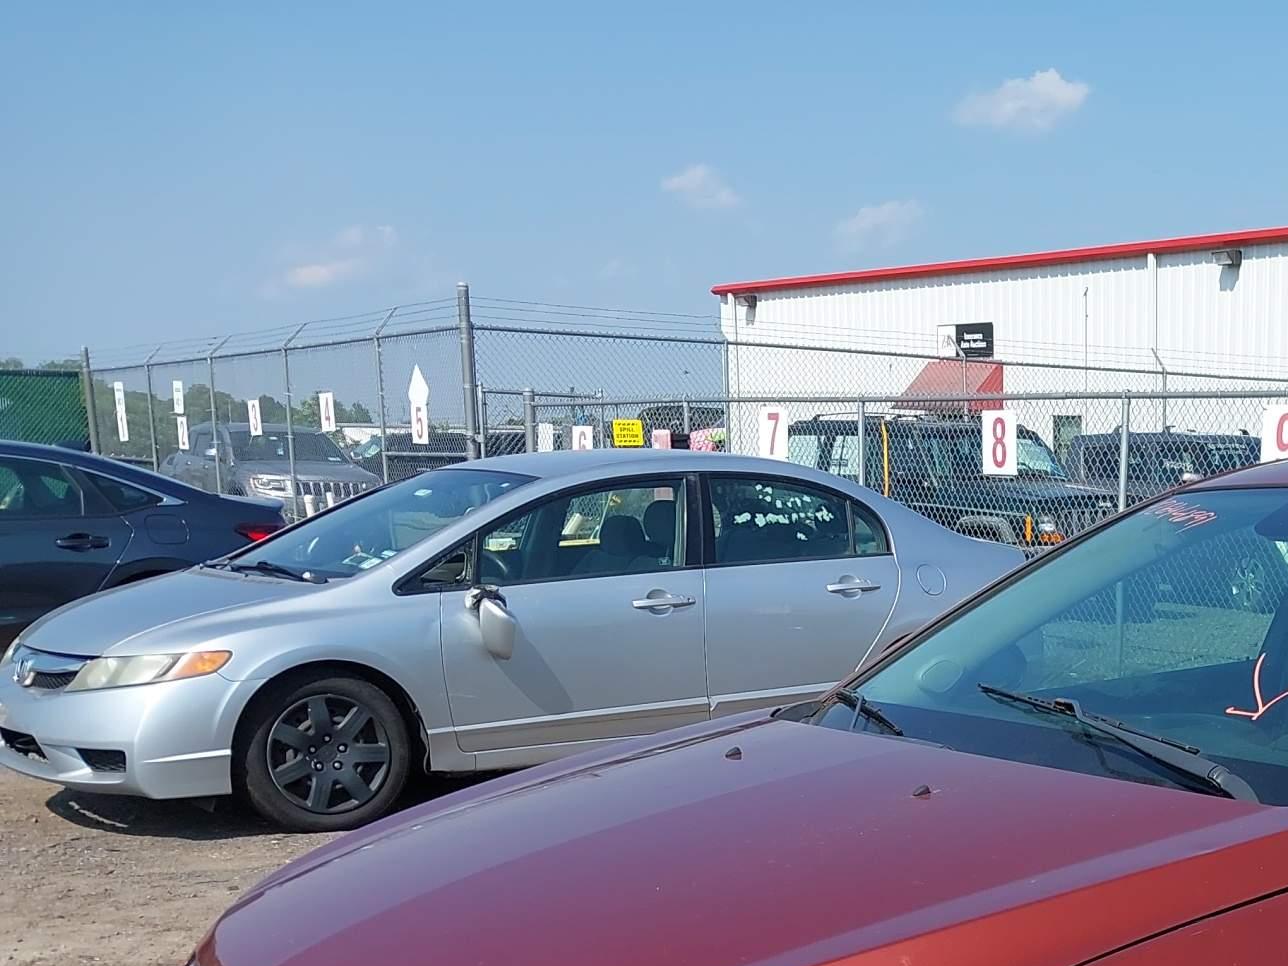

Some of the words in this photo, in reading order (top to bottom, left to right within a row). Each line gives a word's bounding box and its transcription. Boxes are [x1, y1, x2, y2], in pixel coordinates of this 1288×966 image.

[251, 403, 258, 432] 3
[325, 397, 331, 428] 4
[415, 406, 423, 439] 5
[767, 412, 779, 455] 7
[992, 416, 1007, 468] 8
